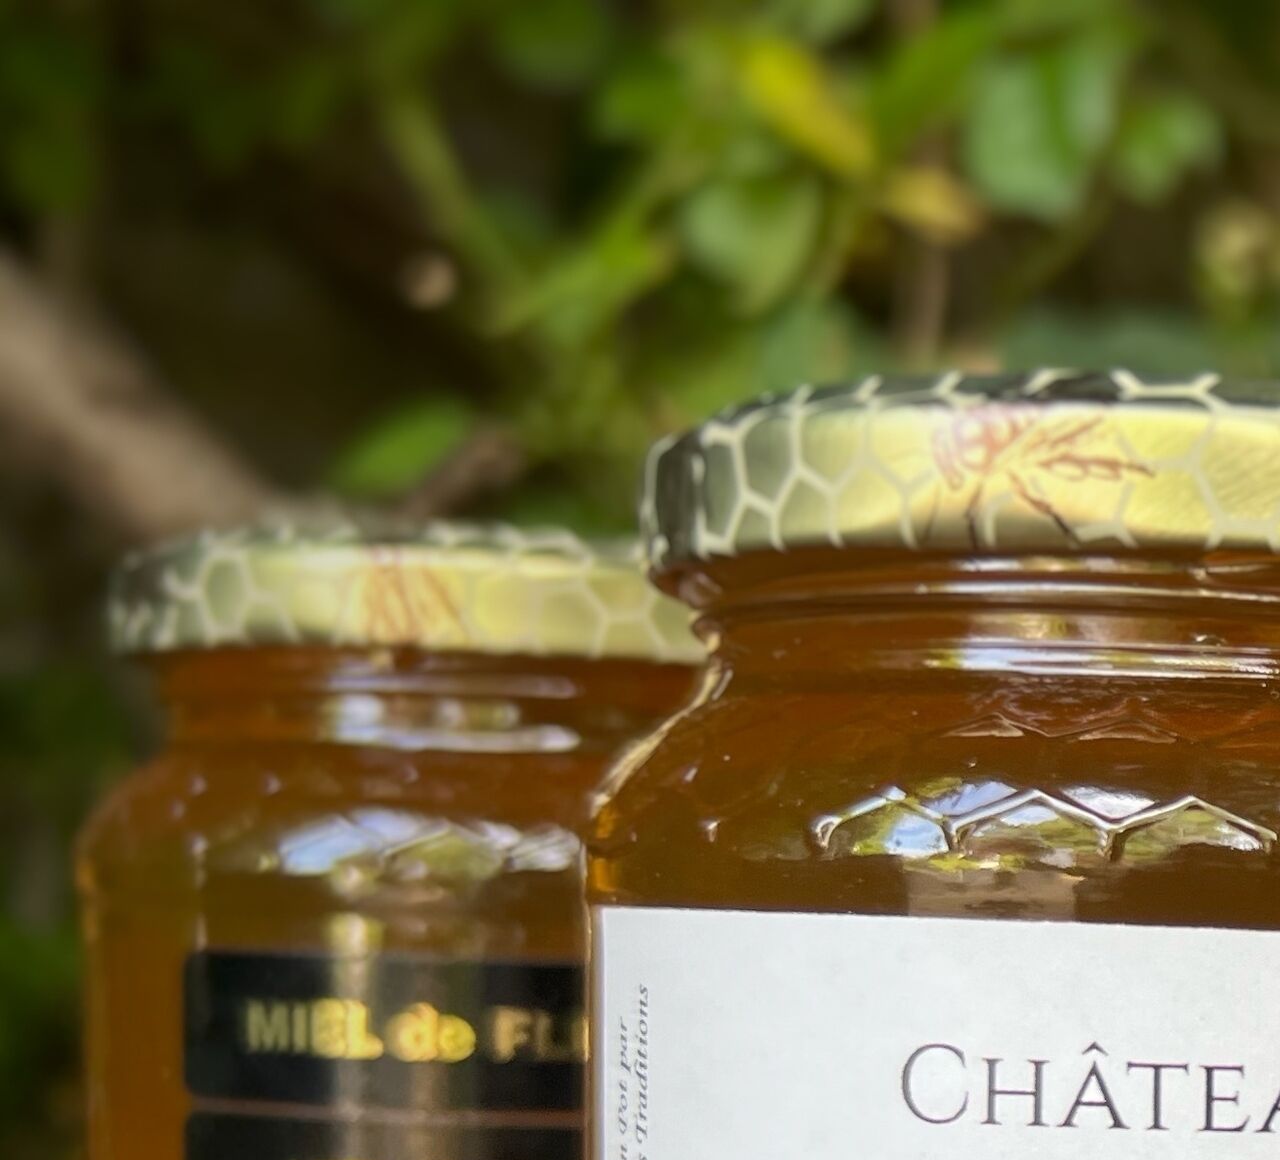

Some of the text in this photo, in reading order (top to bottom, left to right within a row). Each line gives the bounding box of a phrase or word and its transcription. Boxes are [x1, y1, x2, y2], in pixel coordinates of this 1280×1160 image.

[244, 999, 589, 1063] MIEL de FL
[619, 1016, 633, 1071] par
[635, 984, 650, 1146] Traditions
[617, 1083, 629, 1135] Pot
